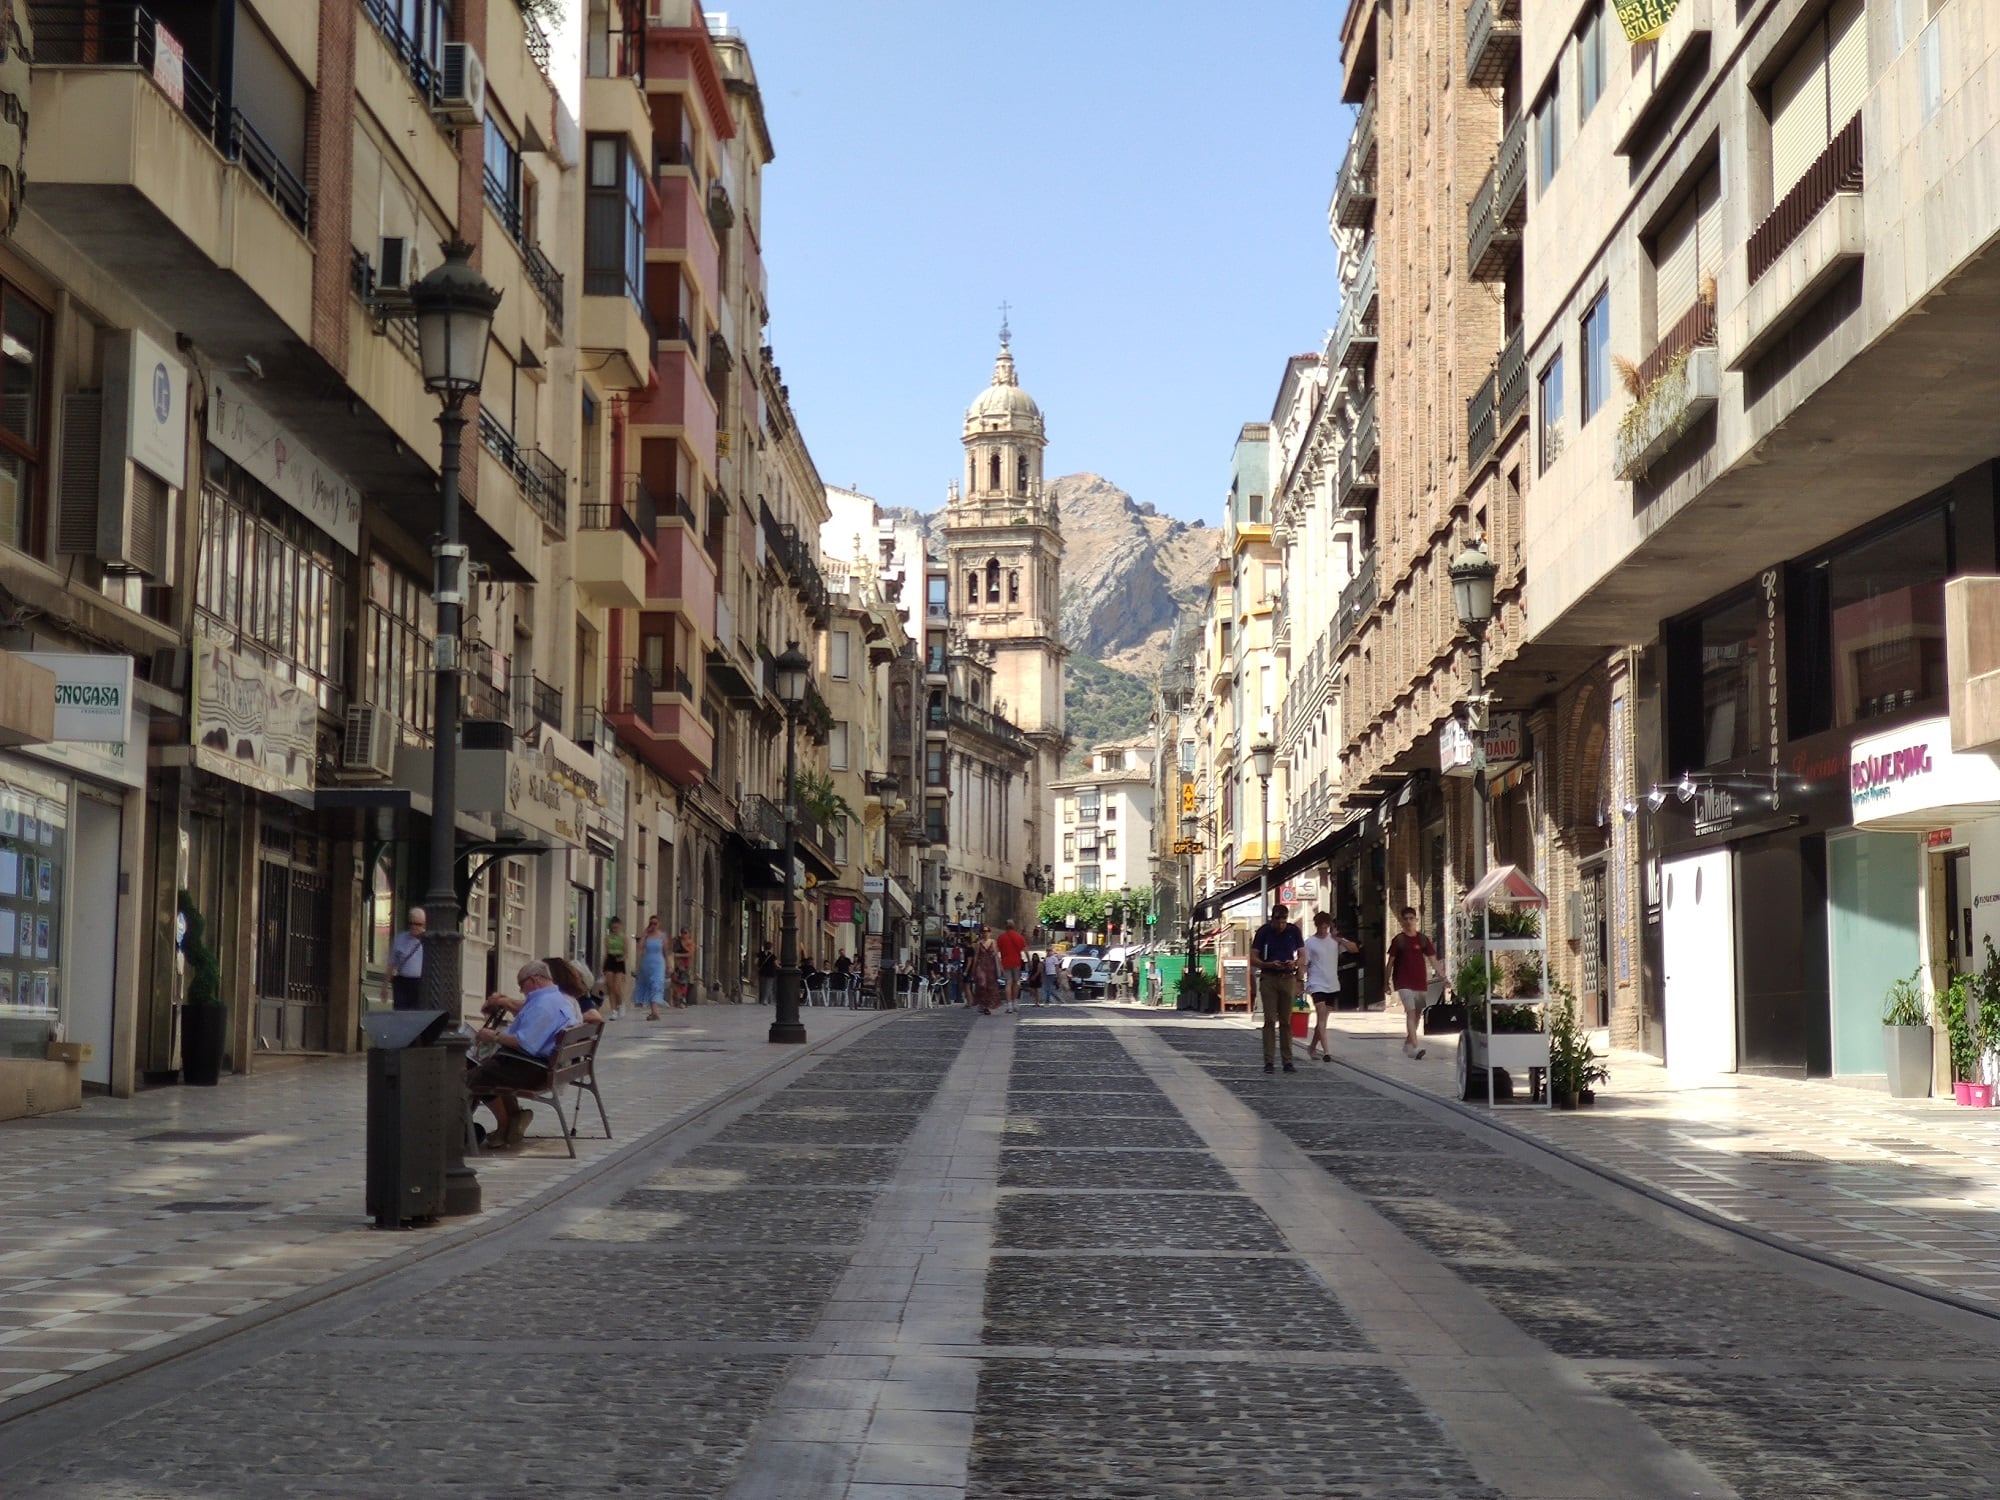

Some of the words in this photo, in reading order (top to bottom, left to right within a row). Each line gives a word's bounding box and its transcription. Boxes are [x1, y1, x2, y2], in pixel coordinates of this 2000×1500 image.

[1619, 2, 1643, 24] 953
[1625, 17, 1649, 39] 670
[1647, 9, 1662, 28] 67
[1762, 571, 1780, 811] Restaurante
[1460, 739, 1517, 758] TODANO
[1695, 800, 1705, 824] La
[1704, 788, 1732, 821] Mafia
[1175, 844, 1202, 854] OPTCA
